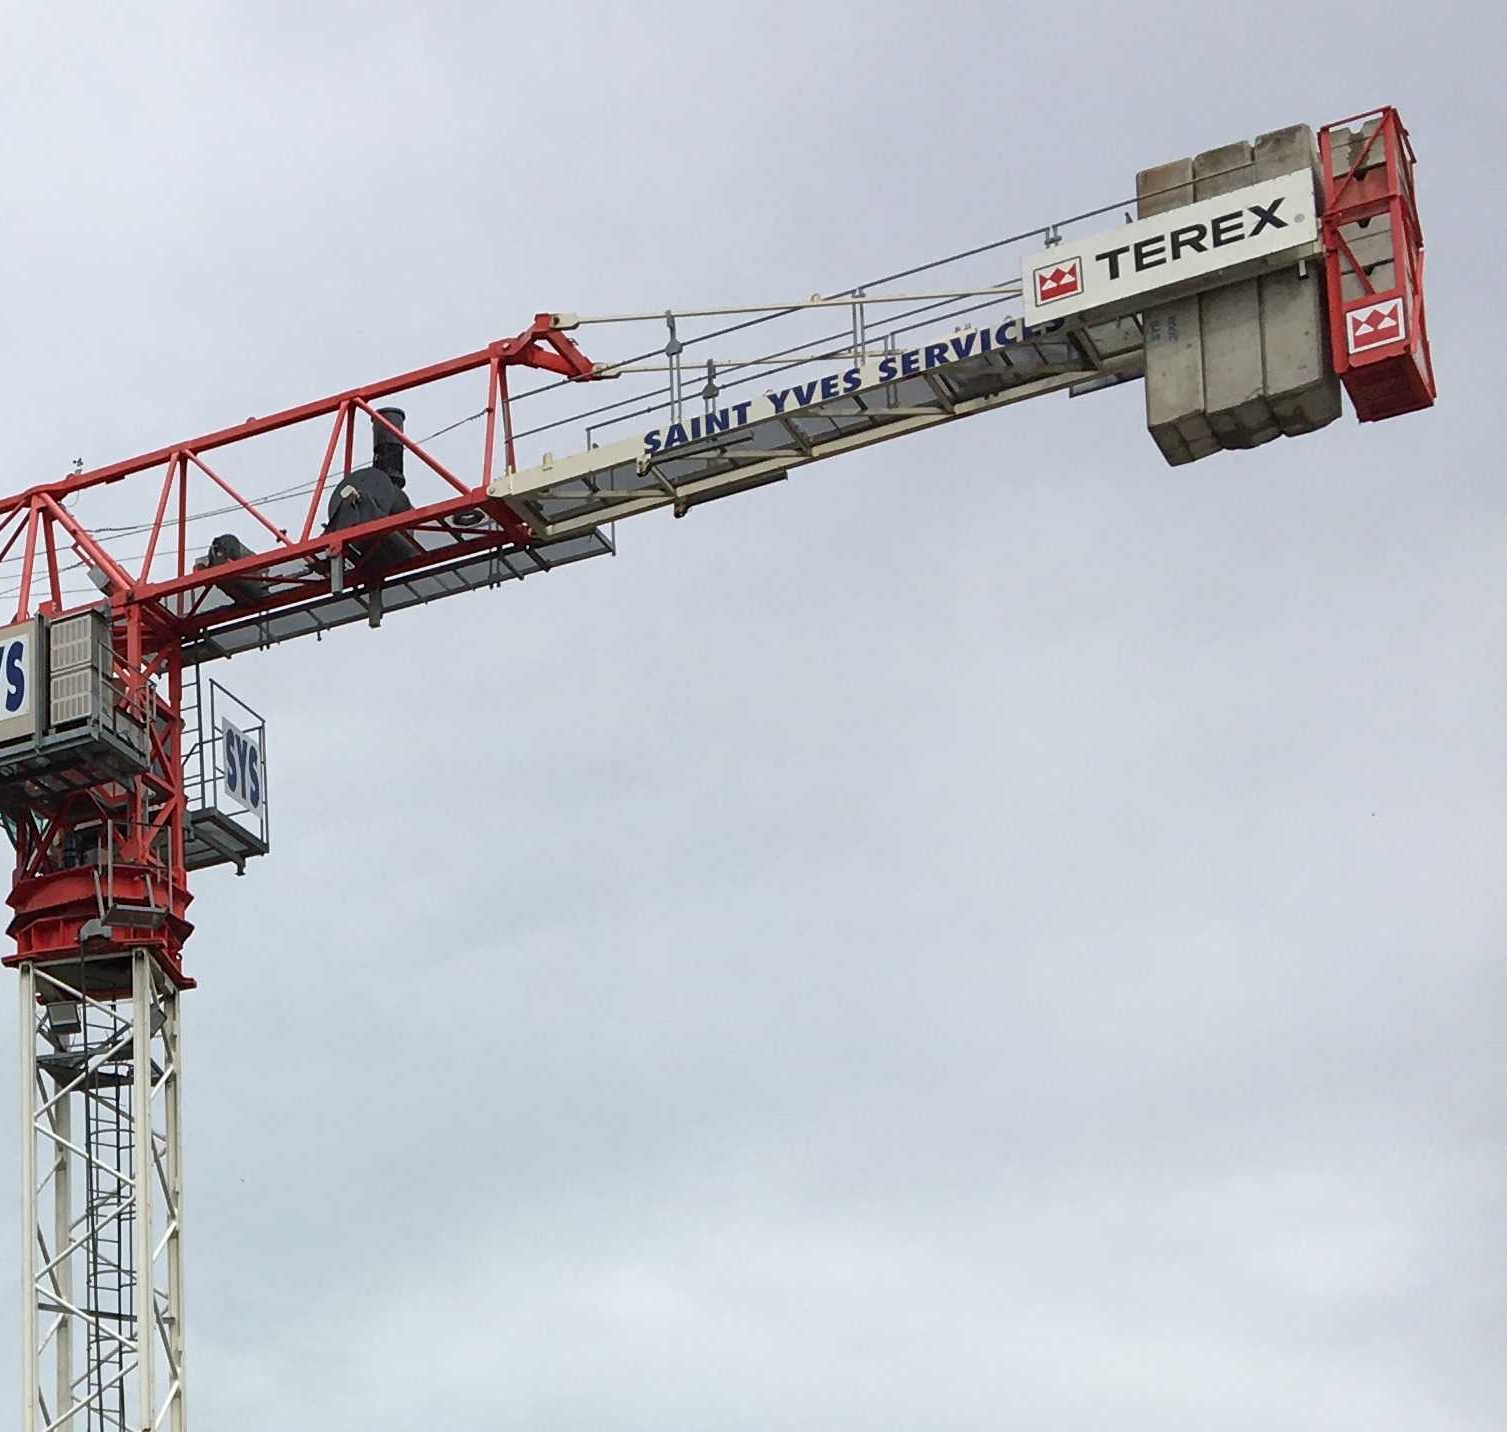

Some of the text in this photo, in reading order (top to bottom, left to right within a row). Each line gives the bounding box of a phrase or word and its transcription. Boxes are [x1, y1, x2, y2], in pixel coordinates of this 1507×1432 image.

[1095, 197, 1289, 281] TEREX
[644, 401, 752, 454] SAINT
[767, 367, 862, 414] YVES
[225, 728, 260, 808] SYS
